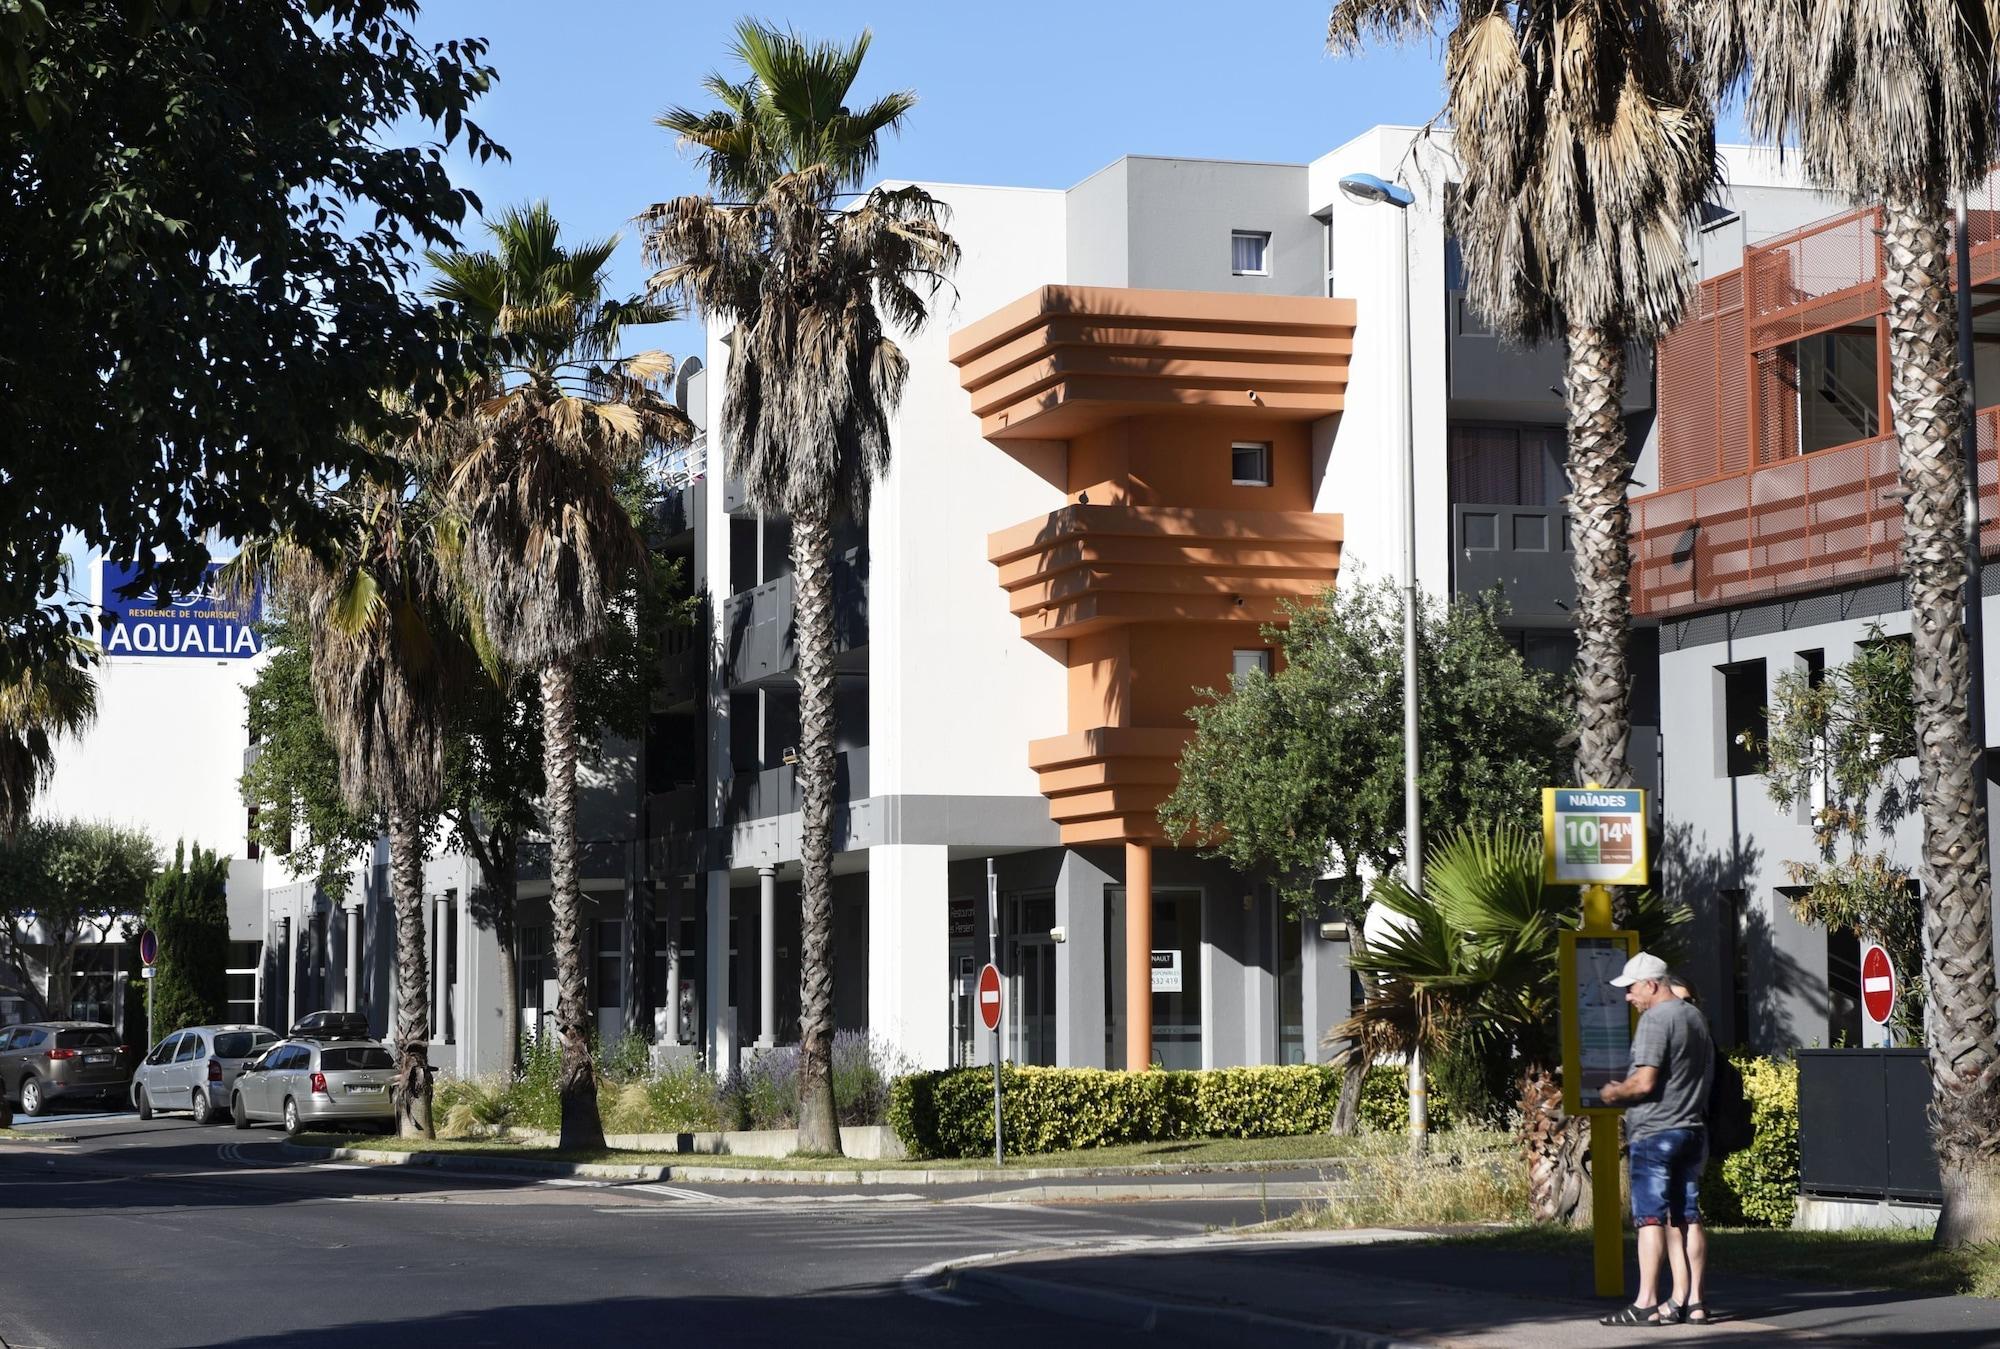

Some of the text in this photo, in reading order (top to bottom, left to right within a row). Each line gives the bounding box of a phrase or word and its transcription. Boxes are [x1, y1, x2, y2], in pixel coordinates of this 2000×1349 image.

[128, 608, 237, 619] RESIDENCE DE TOURISME
[107, 623, 257, 654] AQUALIA
[1569, 792, 1626, 807] NAÏADES
[1566, 821, 1598, 847] 10
